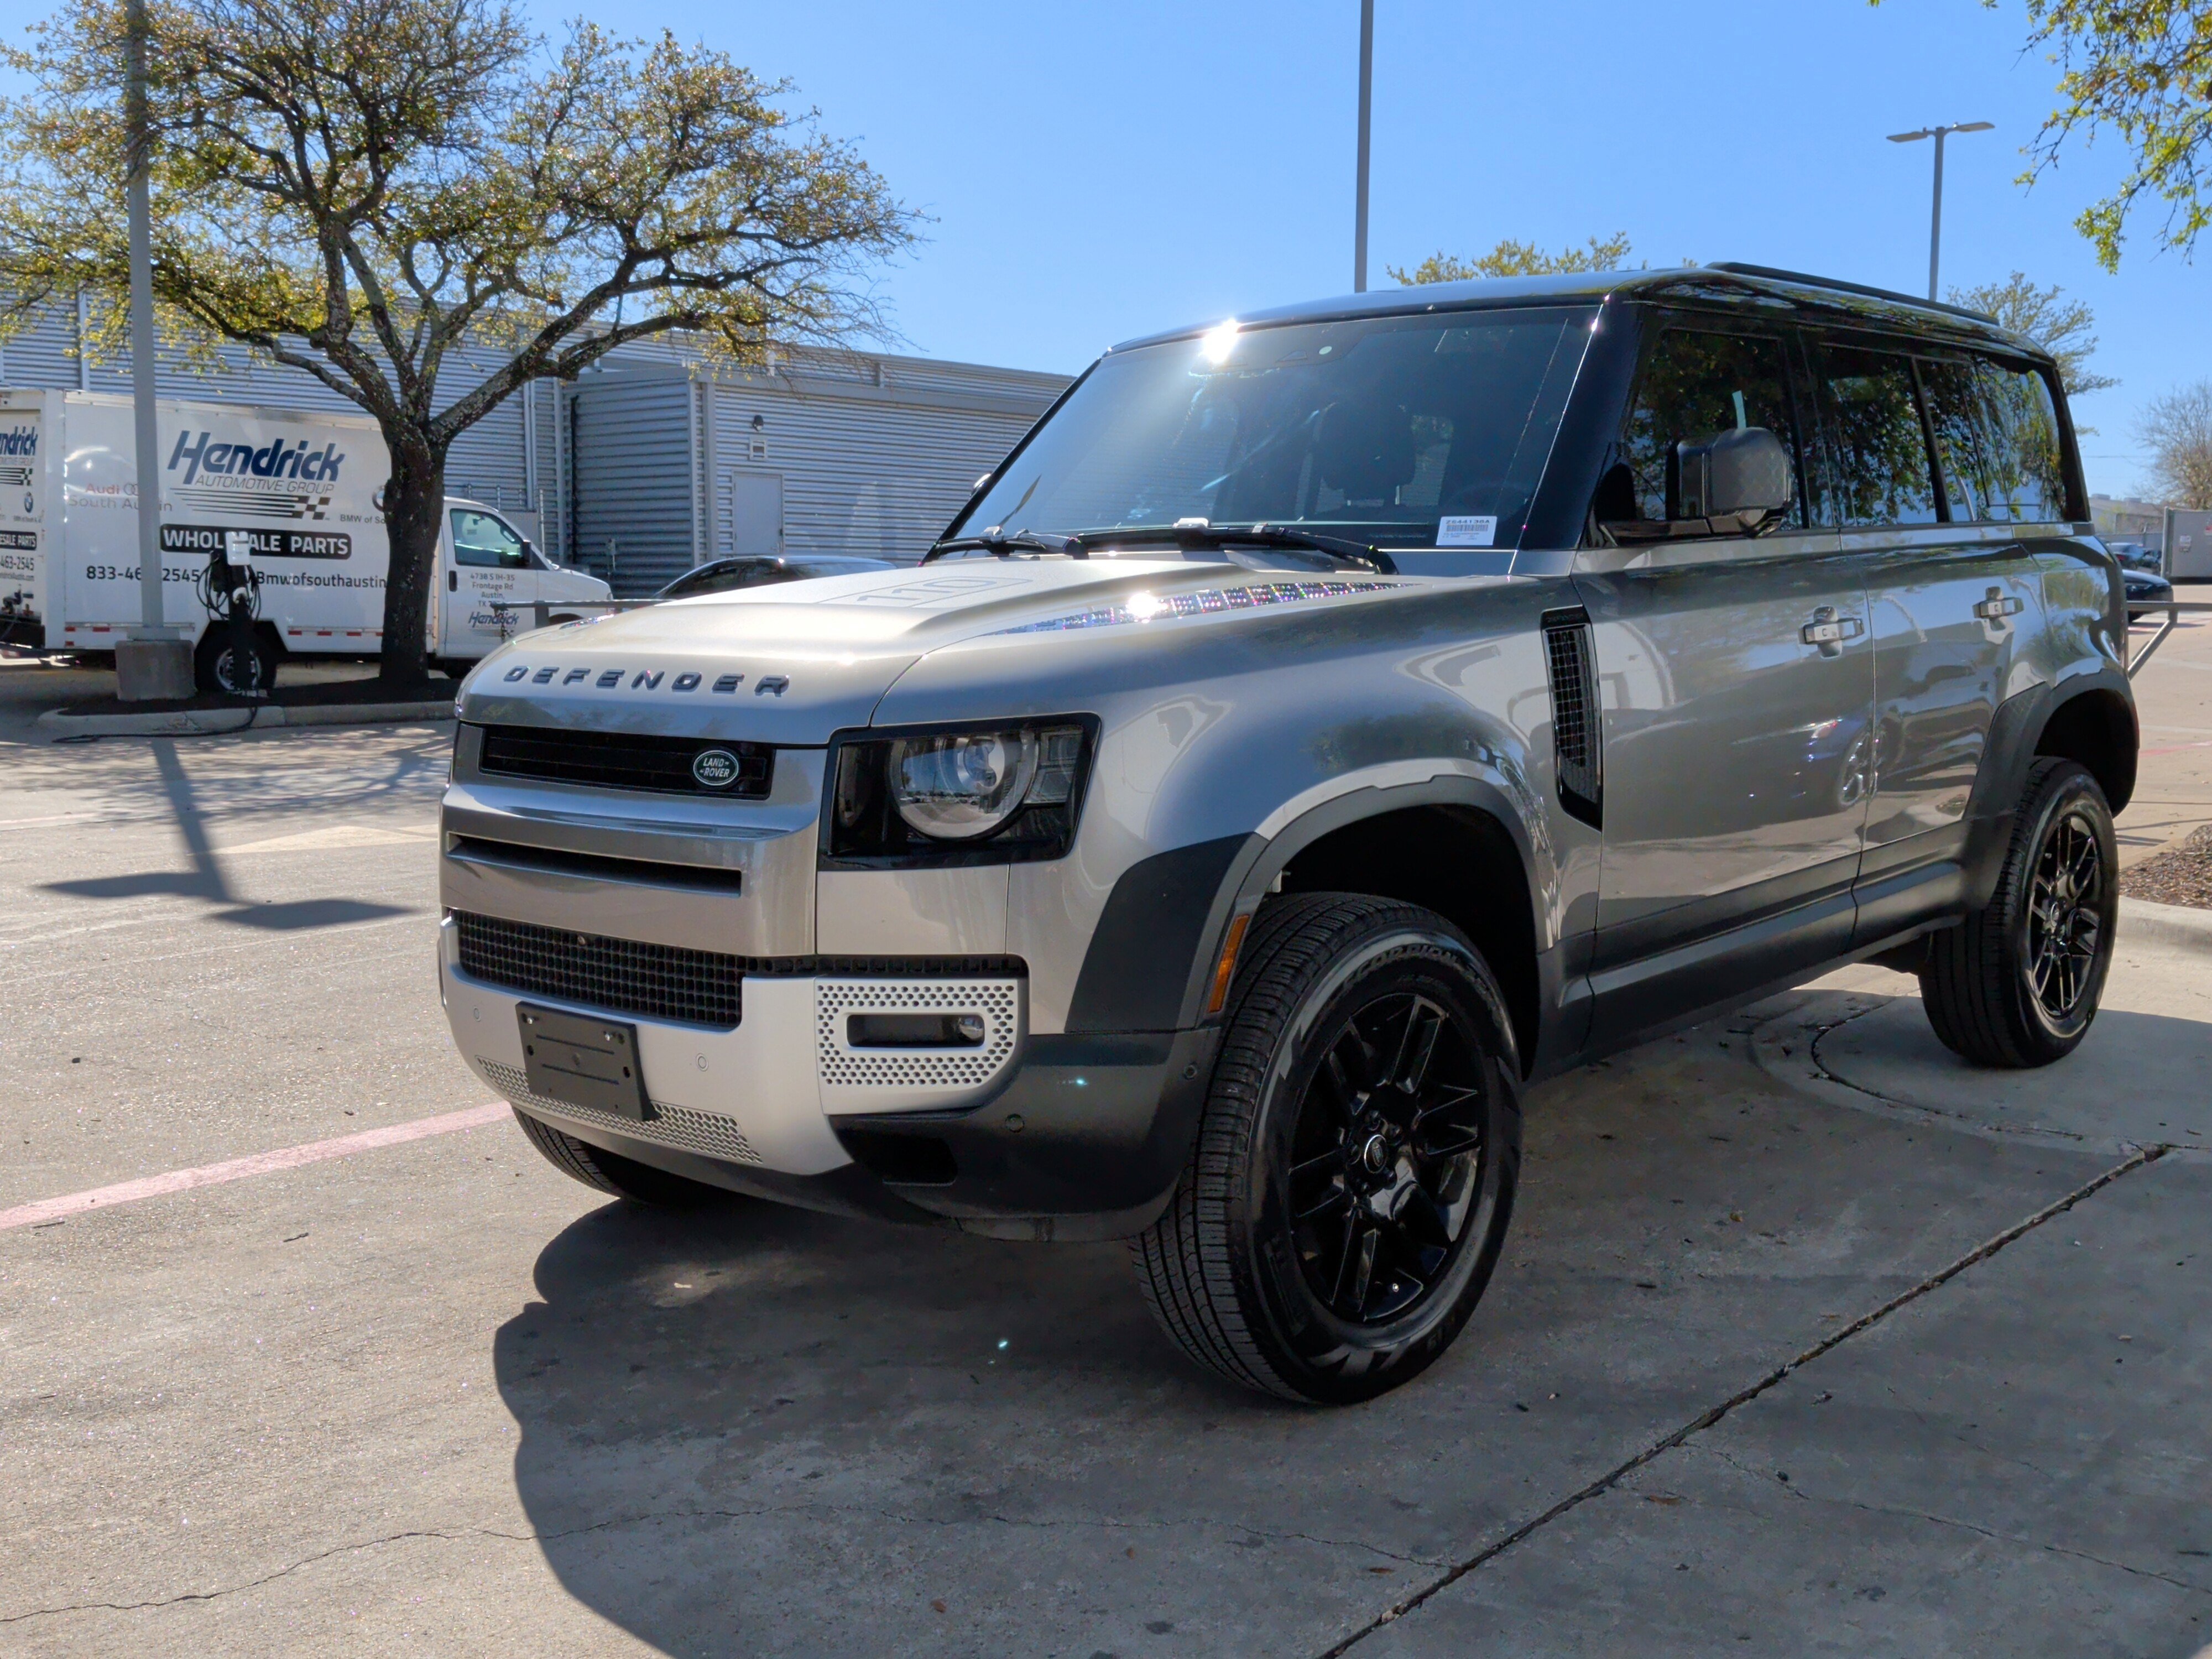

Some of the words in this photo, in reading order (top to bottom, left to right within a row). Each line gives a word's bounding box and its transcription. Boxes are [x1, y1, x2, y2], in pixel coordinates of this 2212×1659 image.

[0, 426, 38, 455] ndrick
[167, 430, 346, 484] Hendrick
[85, 483, 119, 494] Audi
[195, 474, 284, 491] AUTOMOTIVE
[287, 481, 334, 494] GROUP
[68, 497, 117, 508] South
[122, 498, 173, 512] Auin
[340, 514, 362, 523] BMW
[163, 529, 281, 551] WHOLALE
[290, 536, 349, 555] PARTS
[0, 555, 34, 571] 463-2545
[472, 582, 503, 591] Frontage
[503, 665, 790, 696] DEFENDER
